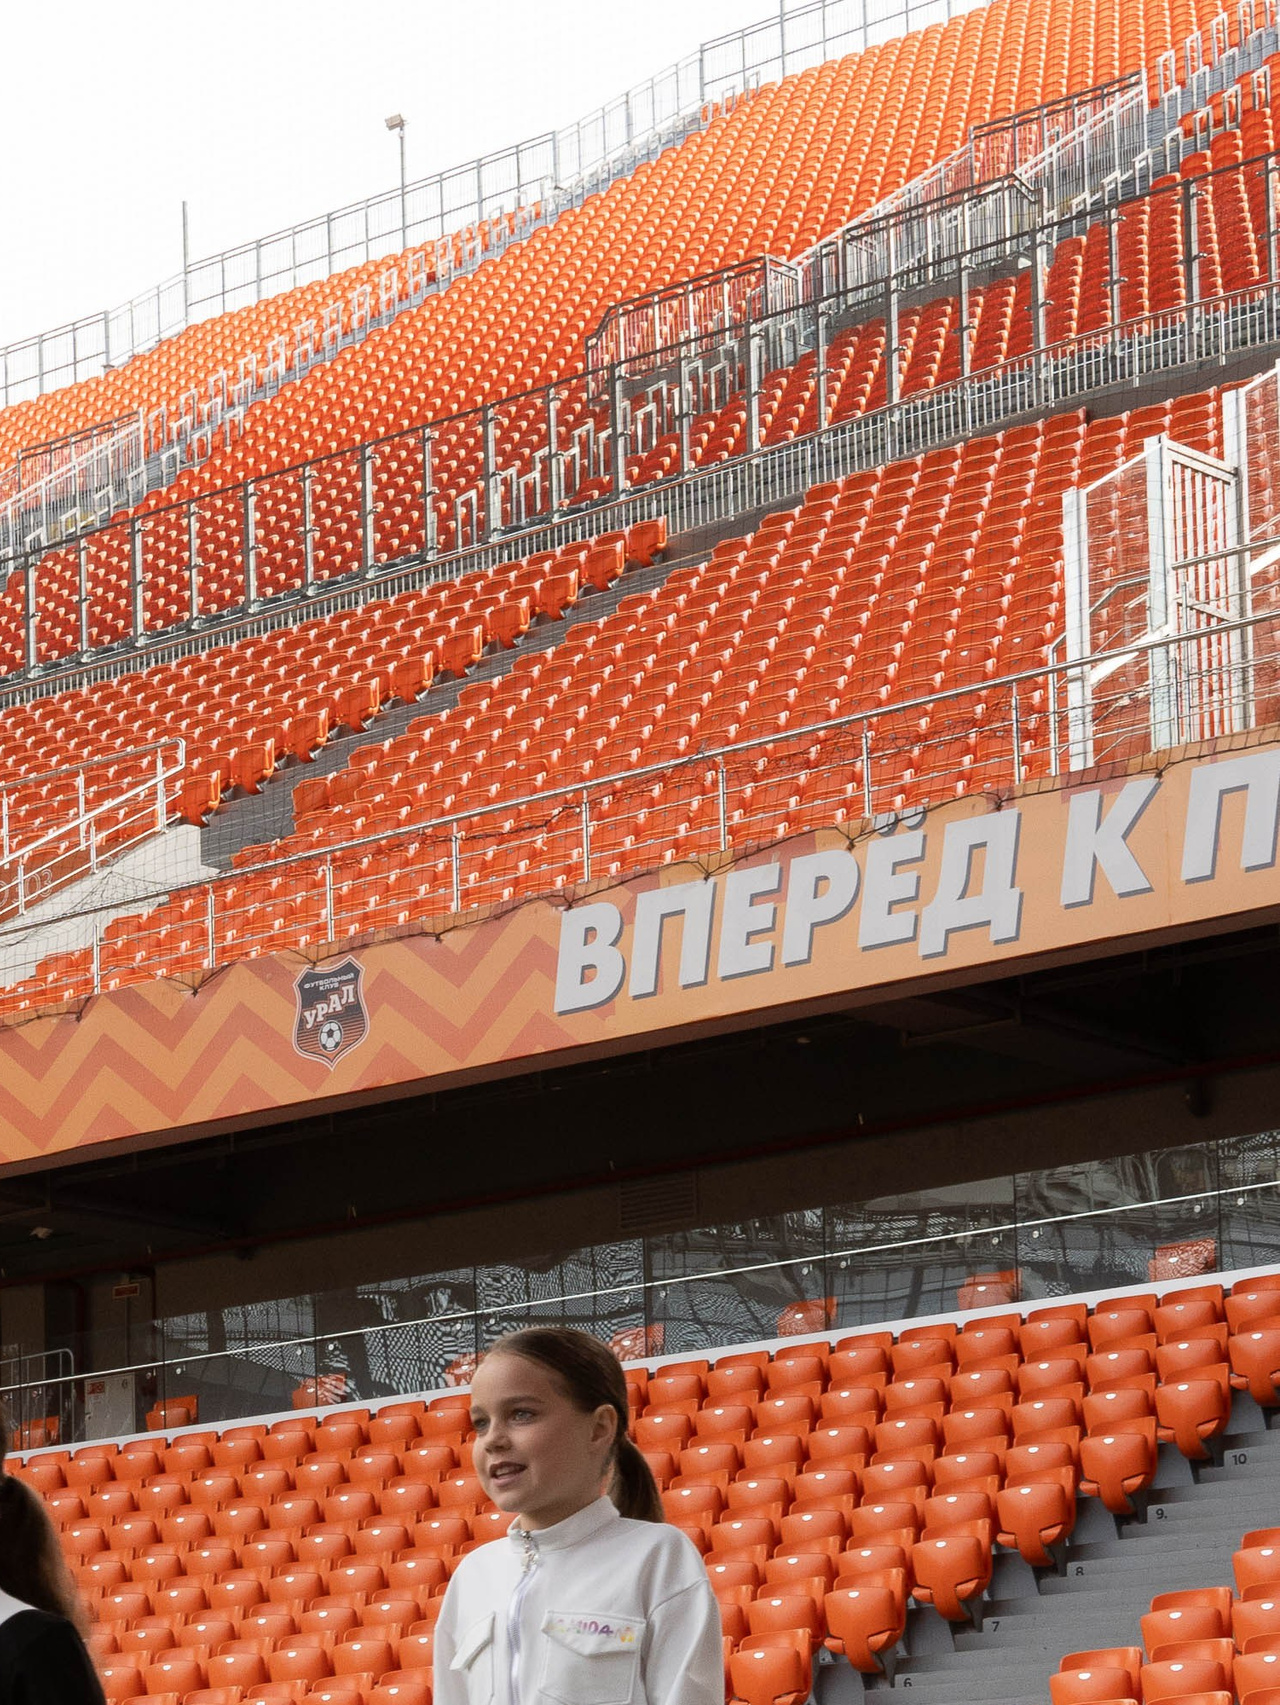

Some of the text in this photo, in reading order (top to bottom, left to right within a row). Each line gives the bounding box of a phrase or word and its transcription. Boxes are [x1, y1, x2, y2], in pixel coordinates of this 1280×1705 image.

[553, 804, 1022, 1015] ВПЕРЁД
[1060, 777, 1163, 910] К
[303, 984, 356, 1029] УРАЛ
[1231, 1453, 1247, 1466] 10
[991, 1620, 1000, 1632] 7
